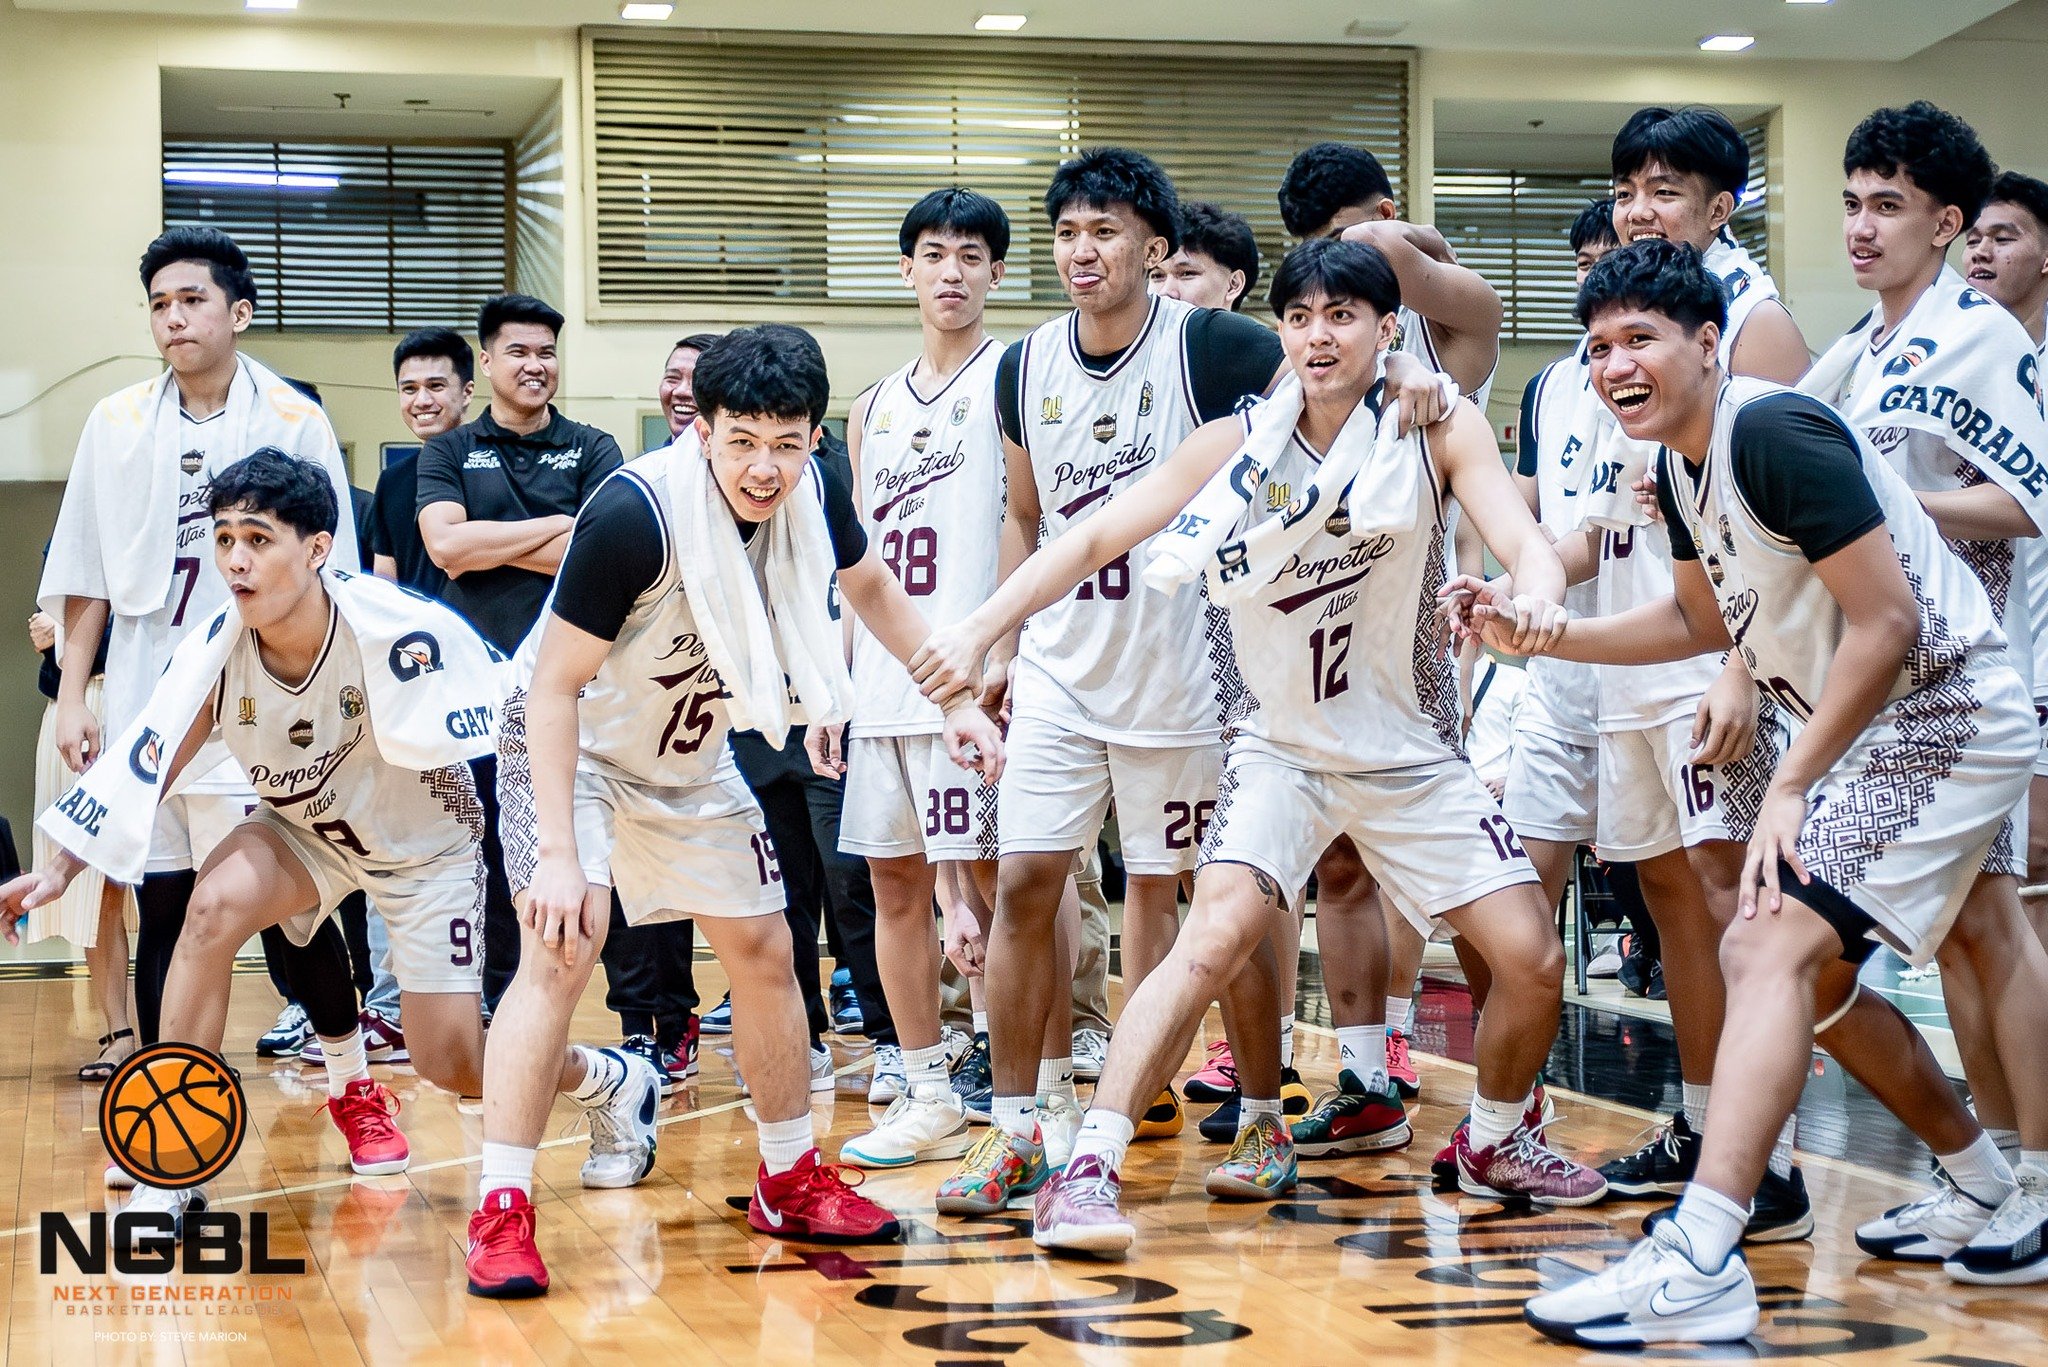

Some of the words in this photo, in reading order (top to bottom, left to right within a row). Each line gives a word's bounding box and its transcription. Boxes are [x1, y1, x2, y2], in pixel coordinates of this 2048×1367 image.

[1879, 384, 2048, 498] GATORADE
[171, 557, 201, 626] 7
[1309, 622, 1353, 704] 12
[446, 706, 493, 739] GAT
[657, 690, 724, 758] 15
[55, 787, 108, 837] ADE
[1681, 764, 1714, 817] 16
[1479, 815, 1527, 861] 12
[450, 918, 473, 966] 9
